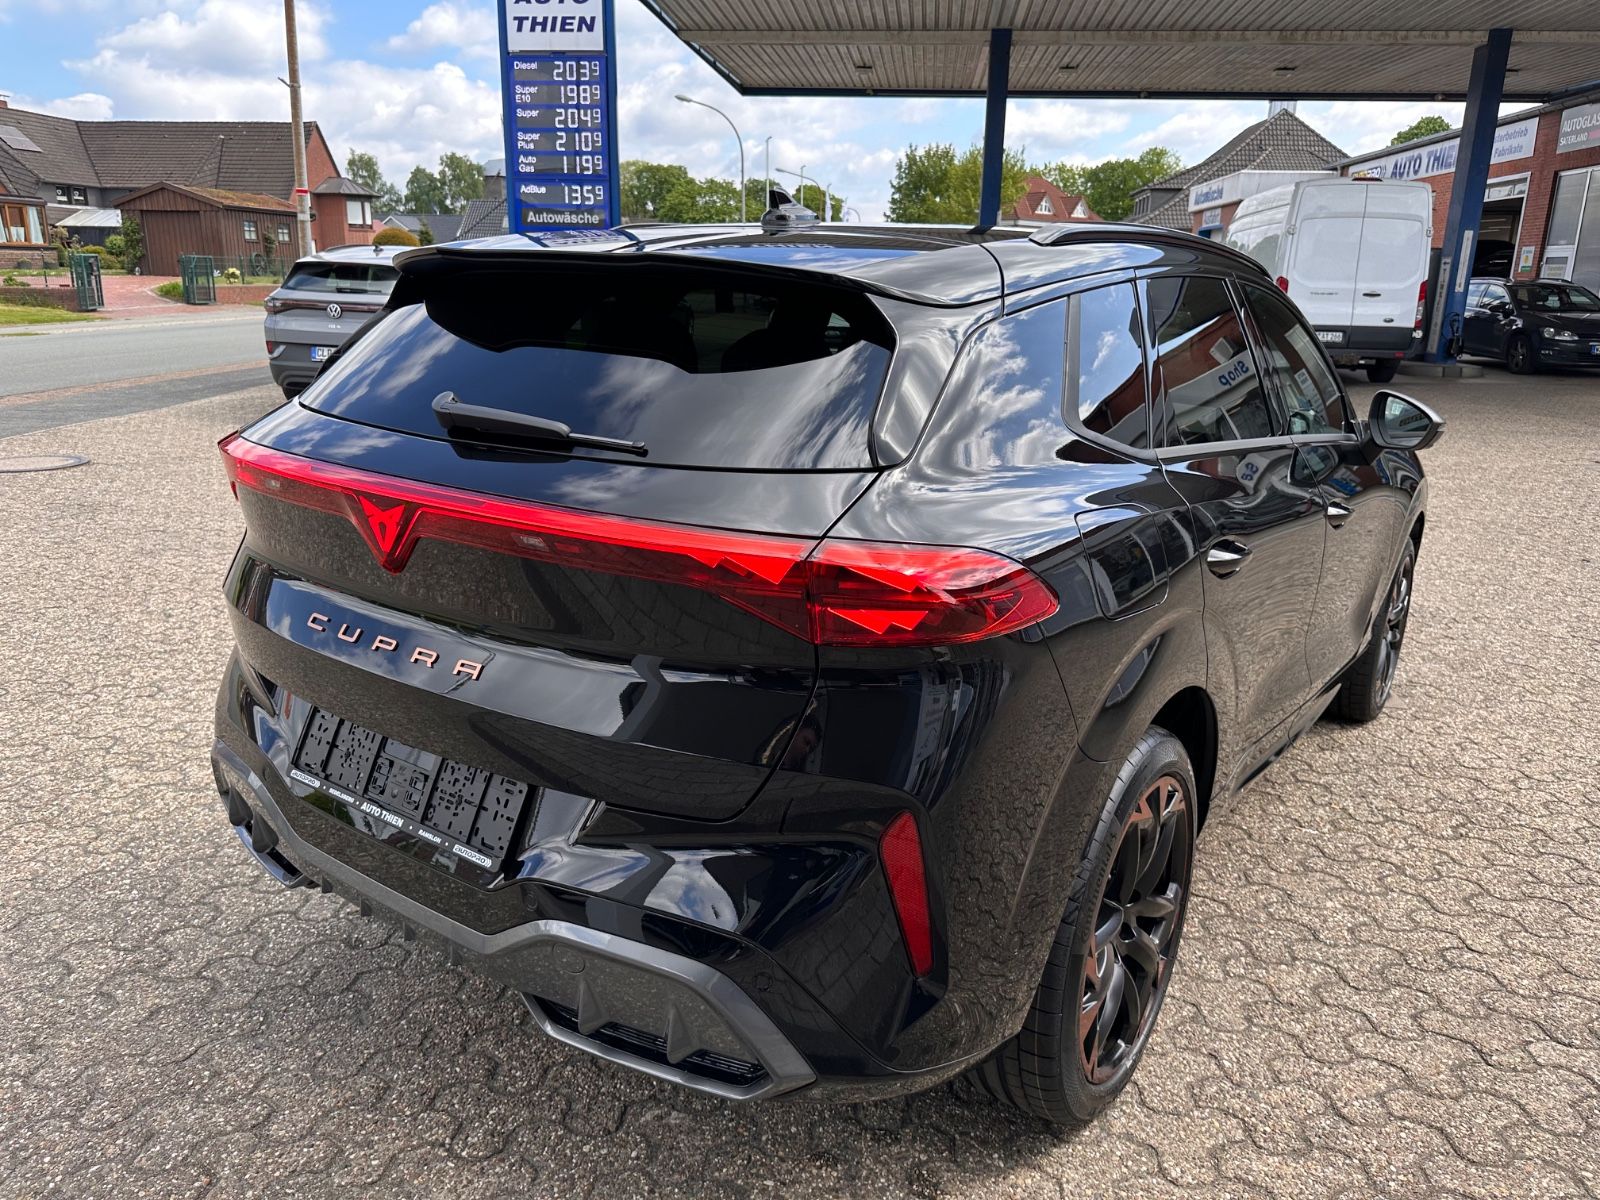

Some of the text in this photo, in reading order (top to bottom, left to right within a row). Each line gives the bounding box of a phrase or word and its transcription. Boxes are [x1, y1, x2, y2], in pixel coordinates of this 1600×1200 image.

[513, 16, 597, 33] THIEN
[514, 61, 538, 70] Diesel
[515, 85, 538, 94] Super
[515, 95, 531, 103] E10
[516, 109, 540, 119] Super
[517, 132, 540, 141] Super
[518, 141, 534, 150] Plus
[519, 155, 536, 164] Auto
[1391, 153, 1422, 179] AUTO
[1425, 144, 1457, 174] THIE
[519, 164, 535, 173] Gas
[520, 185, 546, 194] AdBlue
[527, 211, 600, 224] Autowäsche
[306, 612, 485, 681] CUPRA
[360, 801, 381, 817] AUTO
[380, 810, 405, 828] THIEN
